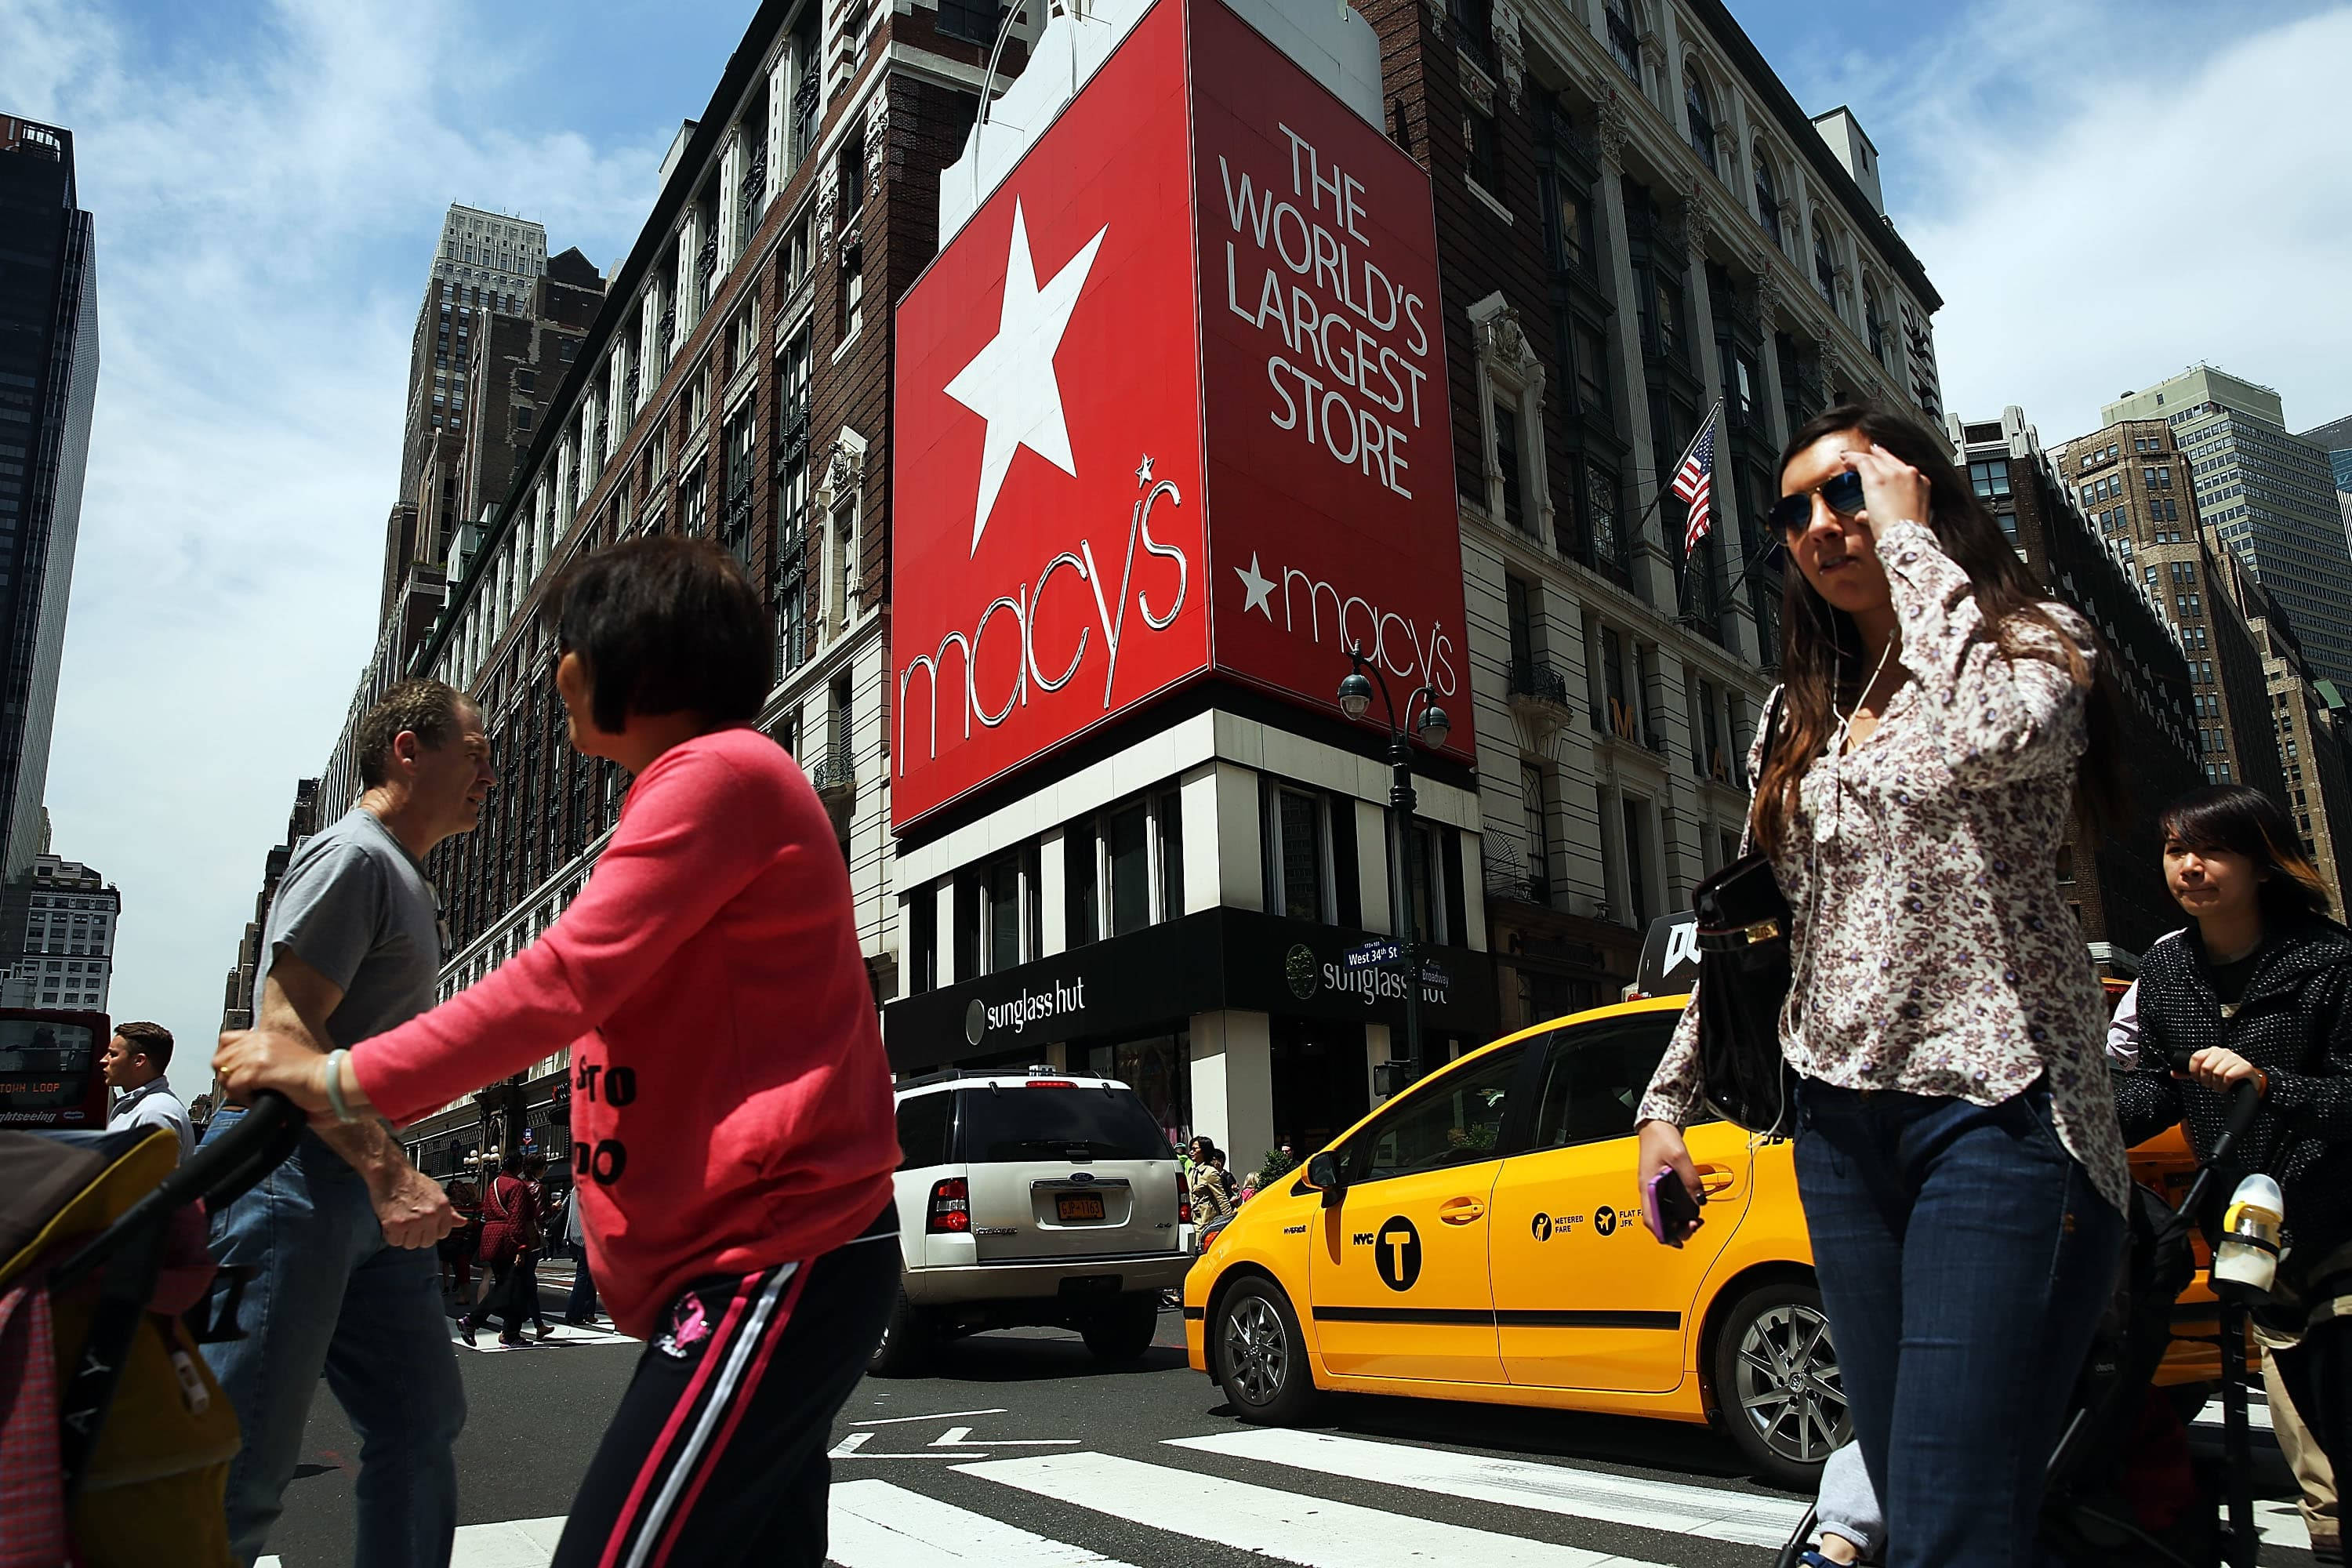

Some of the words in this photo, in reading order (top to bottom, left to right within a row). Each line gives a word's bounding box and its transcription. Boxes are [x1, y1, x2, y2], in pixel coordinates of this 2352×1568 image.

[1279, 121, 1370, 247] THE
[1218, 154, 1428, 357] WORLD'S
[1226, 240, 1427, 428] LARGEST
[1267, 355, 1412, 500] STORE
[1348, 952, 1370, 966] West
[1371, 947, 1387, 962] 34th
[1388, 946, 1398, 959] St
[1422, 968, 1449, 988] Broadway
[987, 988, 1053, 1033] sunglass
[1056, 977, 1085, 1014] hut
[33, 1083, 61, 1092] LOOP
[1352, 1233, 1374, 1245] NYC
[1555, 1215, 1584, 1225] METERED
[1385, 1232, 1410, 1281] T
